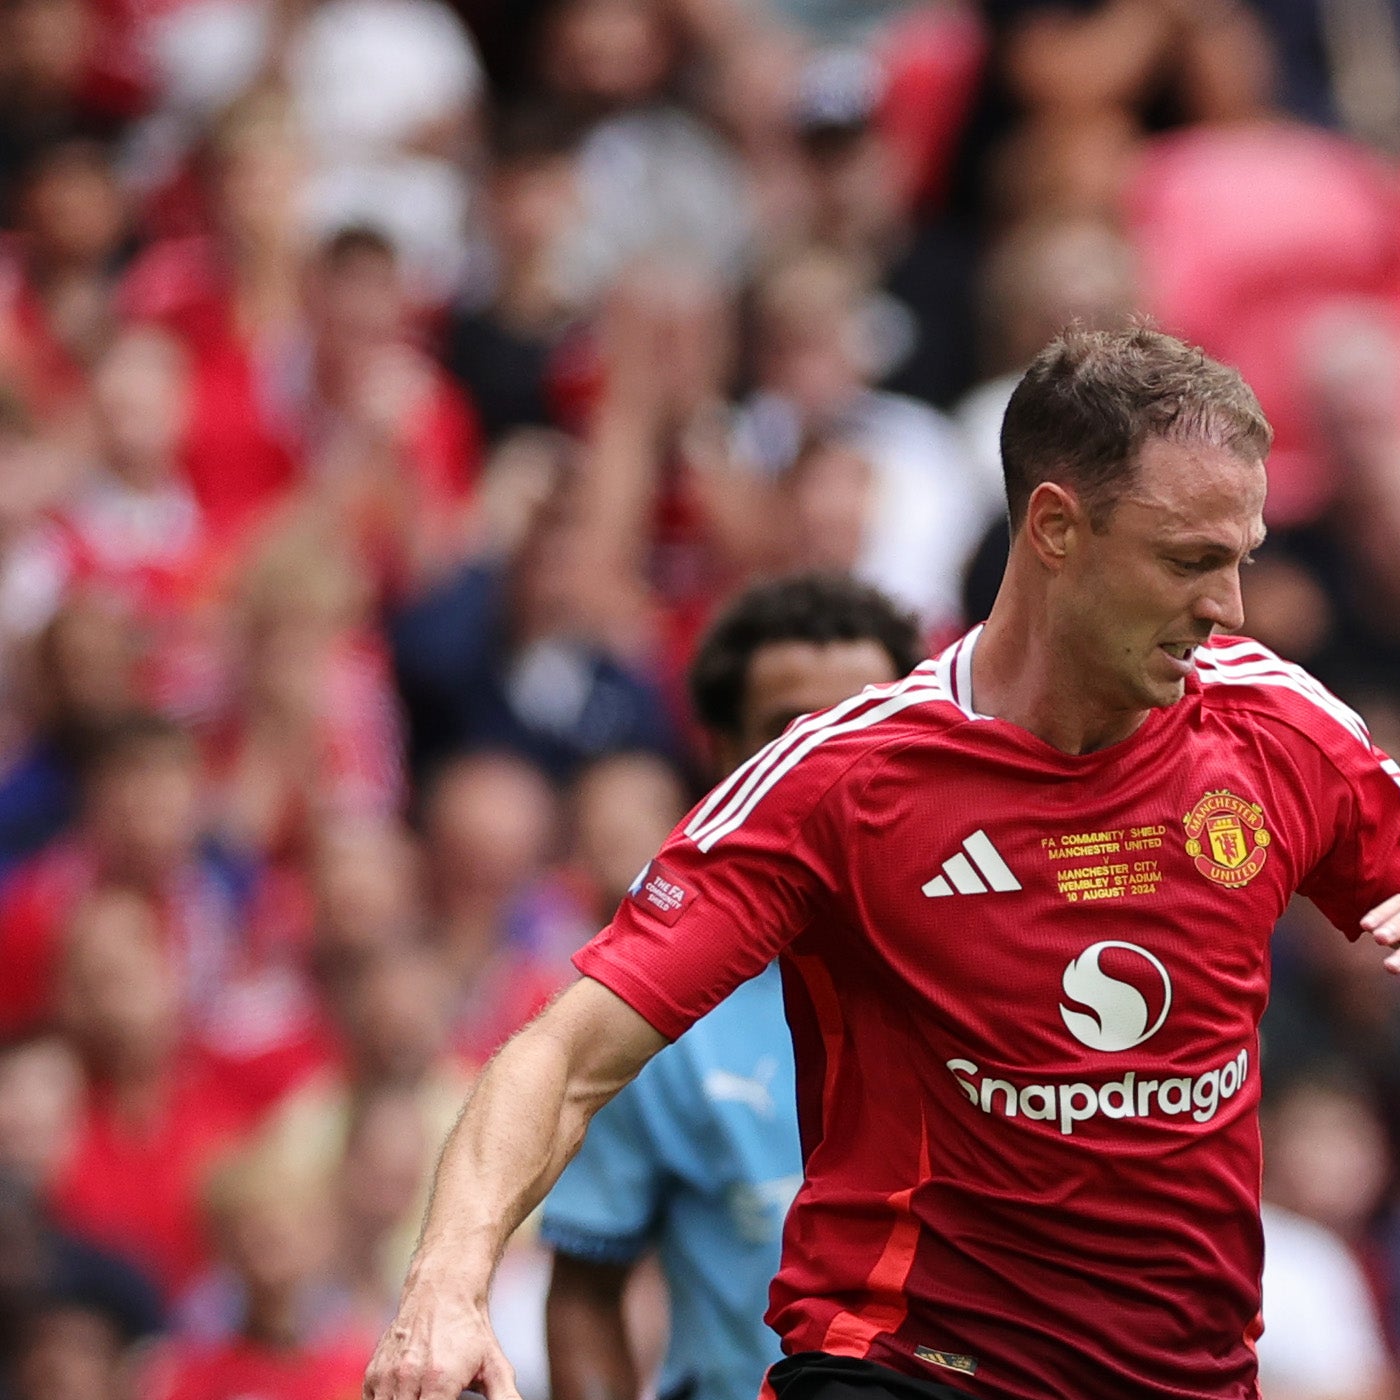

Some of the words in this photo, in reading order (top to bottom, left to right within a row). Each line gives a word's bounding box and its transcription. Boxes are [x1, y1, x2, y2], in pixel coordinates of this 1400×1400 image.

[1191, 796, 1258, 833] MANCHESTER
[1041, 838, 1056, 849] FA
[1060, 830, 1125, 846] COMMUNITY
[1130, 825, 1166, 837] SHIELD
[1048, 844, 1120, 860] MANCHESTER
[1124, 838, 1162, 850] UNITED
[1057, 863, 1129, 881] MANCHESTER
[1133, 860, 1159, 872] CITY
[1209, 860, 1257, 882] UNITED
[653, 875, 672, 892] THE
[668, 885, 685, 902] FA
[1057, 878, 1110, 893] WEMBLEY
[1114, 872, 1163, 885] STADIUM
[1067, 891, 1078, 902] 10
[1083, 888, 1126, 901] AUGUST
[1131, 884, 1156, 895] 2024
[946, 1048, 1248, 1135] Snapdragon
